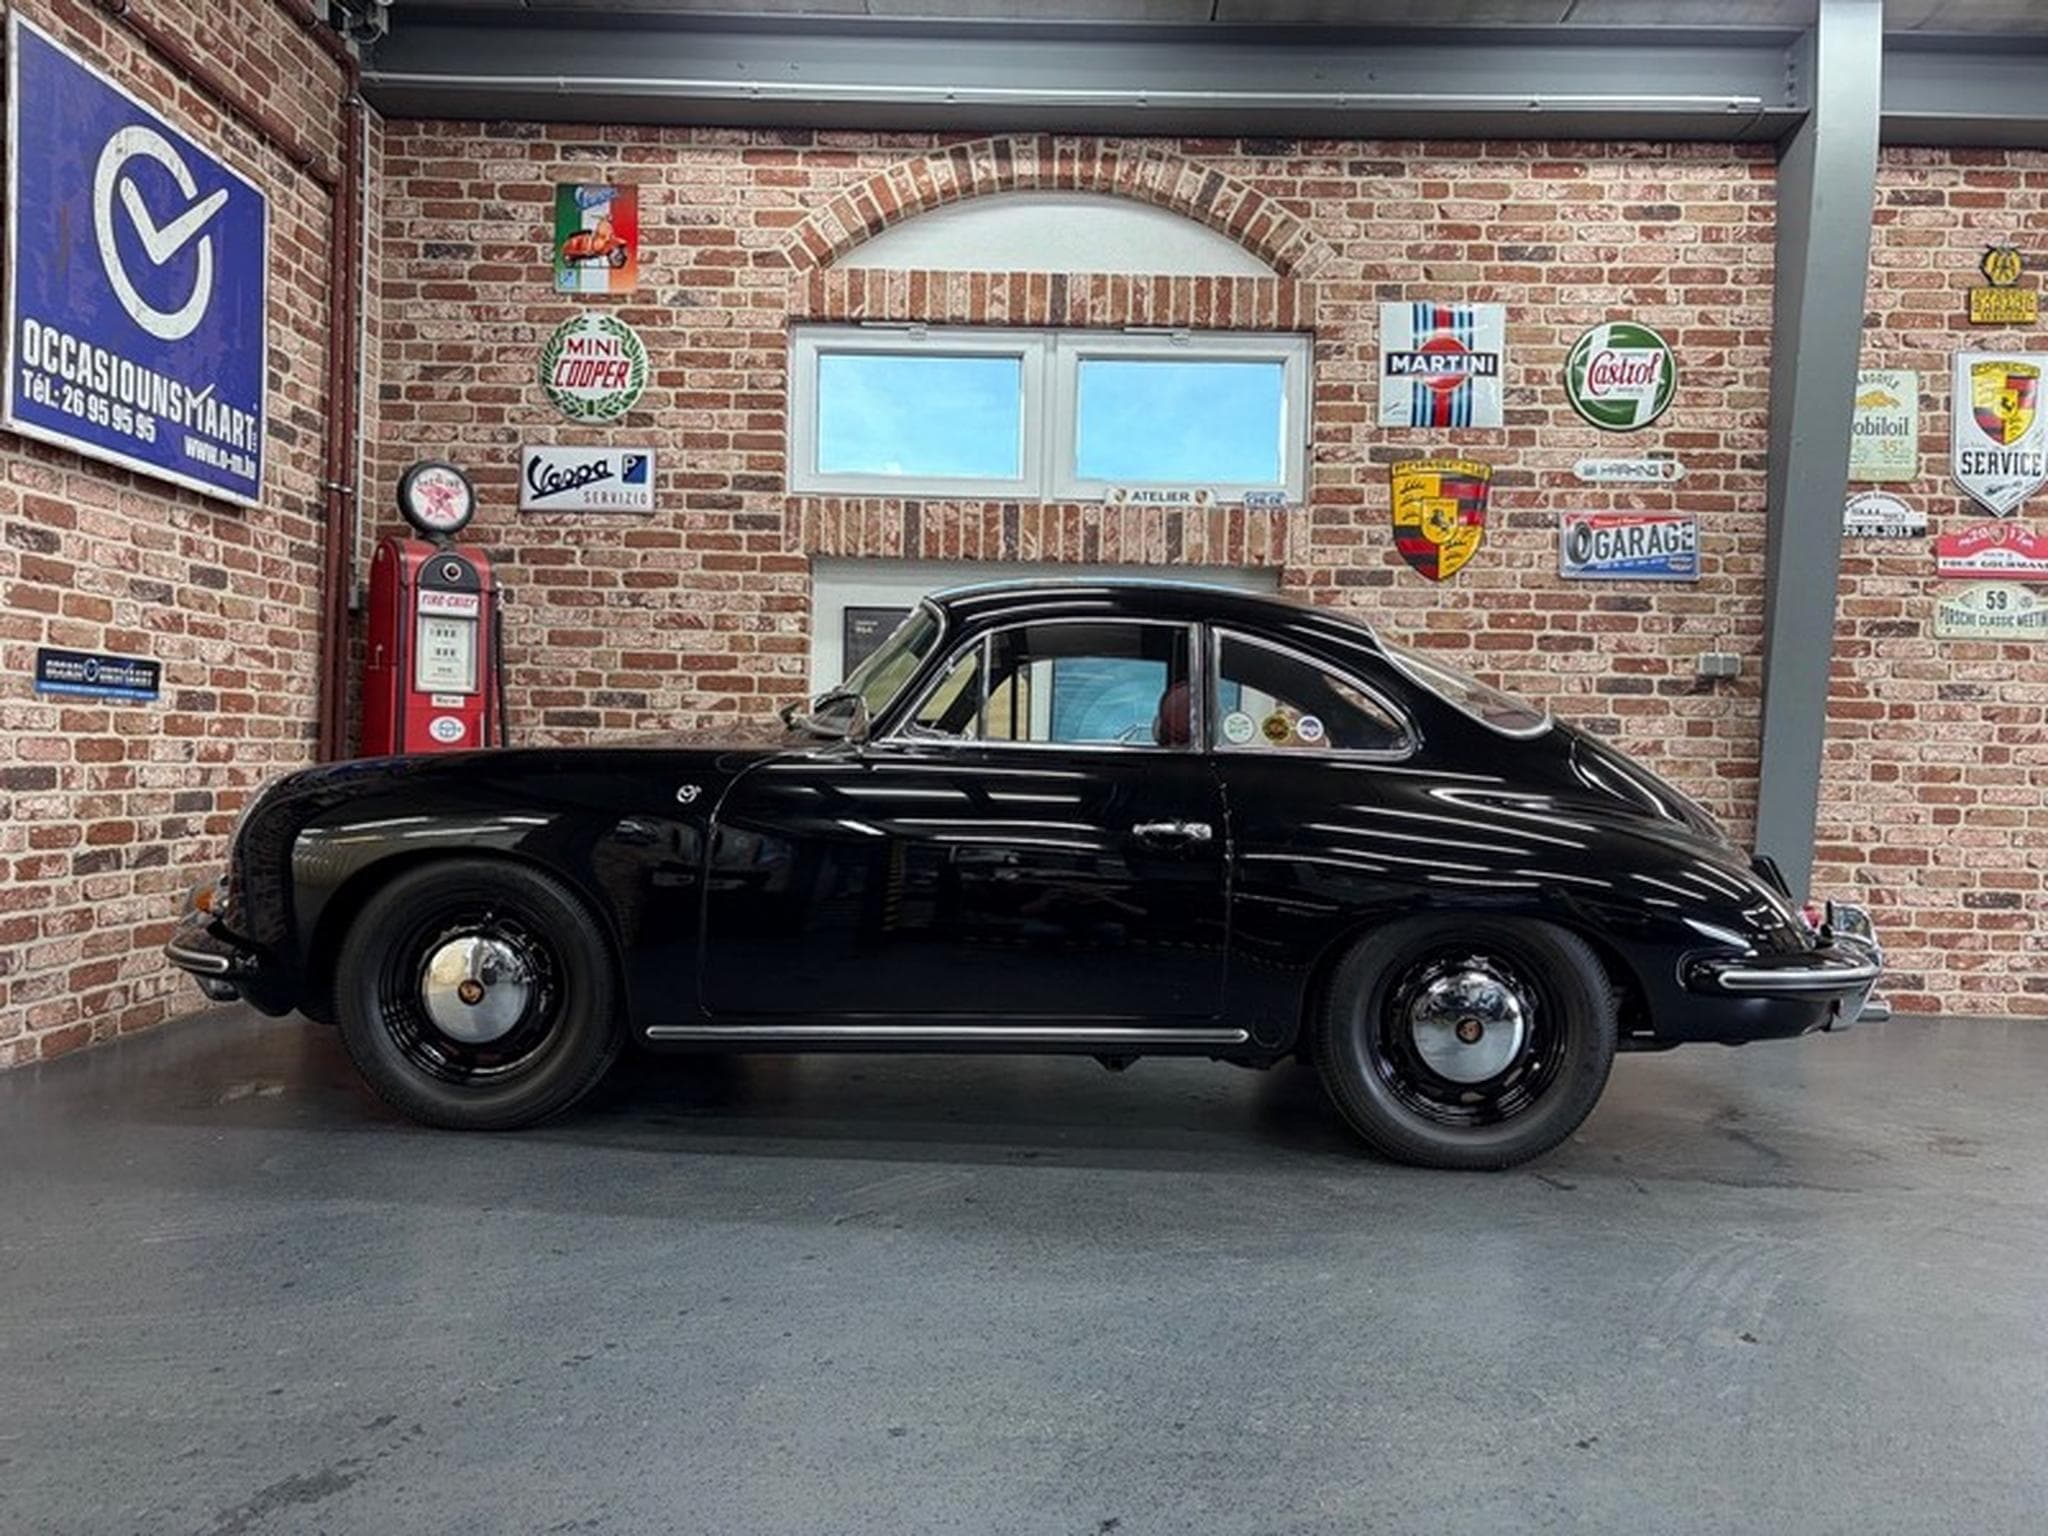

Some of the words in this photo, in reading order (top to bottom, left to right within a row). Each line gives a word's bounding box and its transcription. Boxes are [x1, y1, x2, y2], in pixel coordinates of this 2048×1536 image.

[567, 338, 618, 356] MINI
[555, 359, 630, 389] COOPER
[1391, 354, 1494, 373] MARTINI
[1588, 350, 1662, 397] Castrol
[62, 384, 85, 418] 26
[87, 393, 110, 427] 95
[112, 403, 134, 435] 95
[135, 412, 157, 444] 95
[1852, 416, 1909, 437] obiloil
[1961, 451, 2042, 477] SERVICE
[527, 455, 615, 501] Vespa
[583, 490, 648, 505] SERVIZIO
[1131, 491, 1191, 502] ATELIER
[1594, 521, 1694, 561] GARAGE
[1985, 590, 2008, 611] 59
